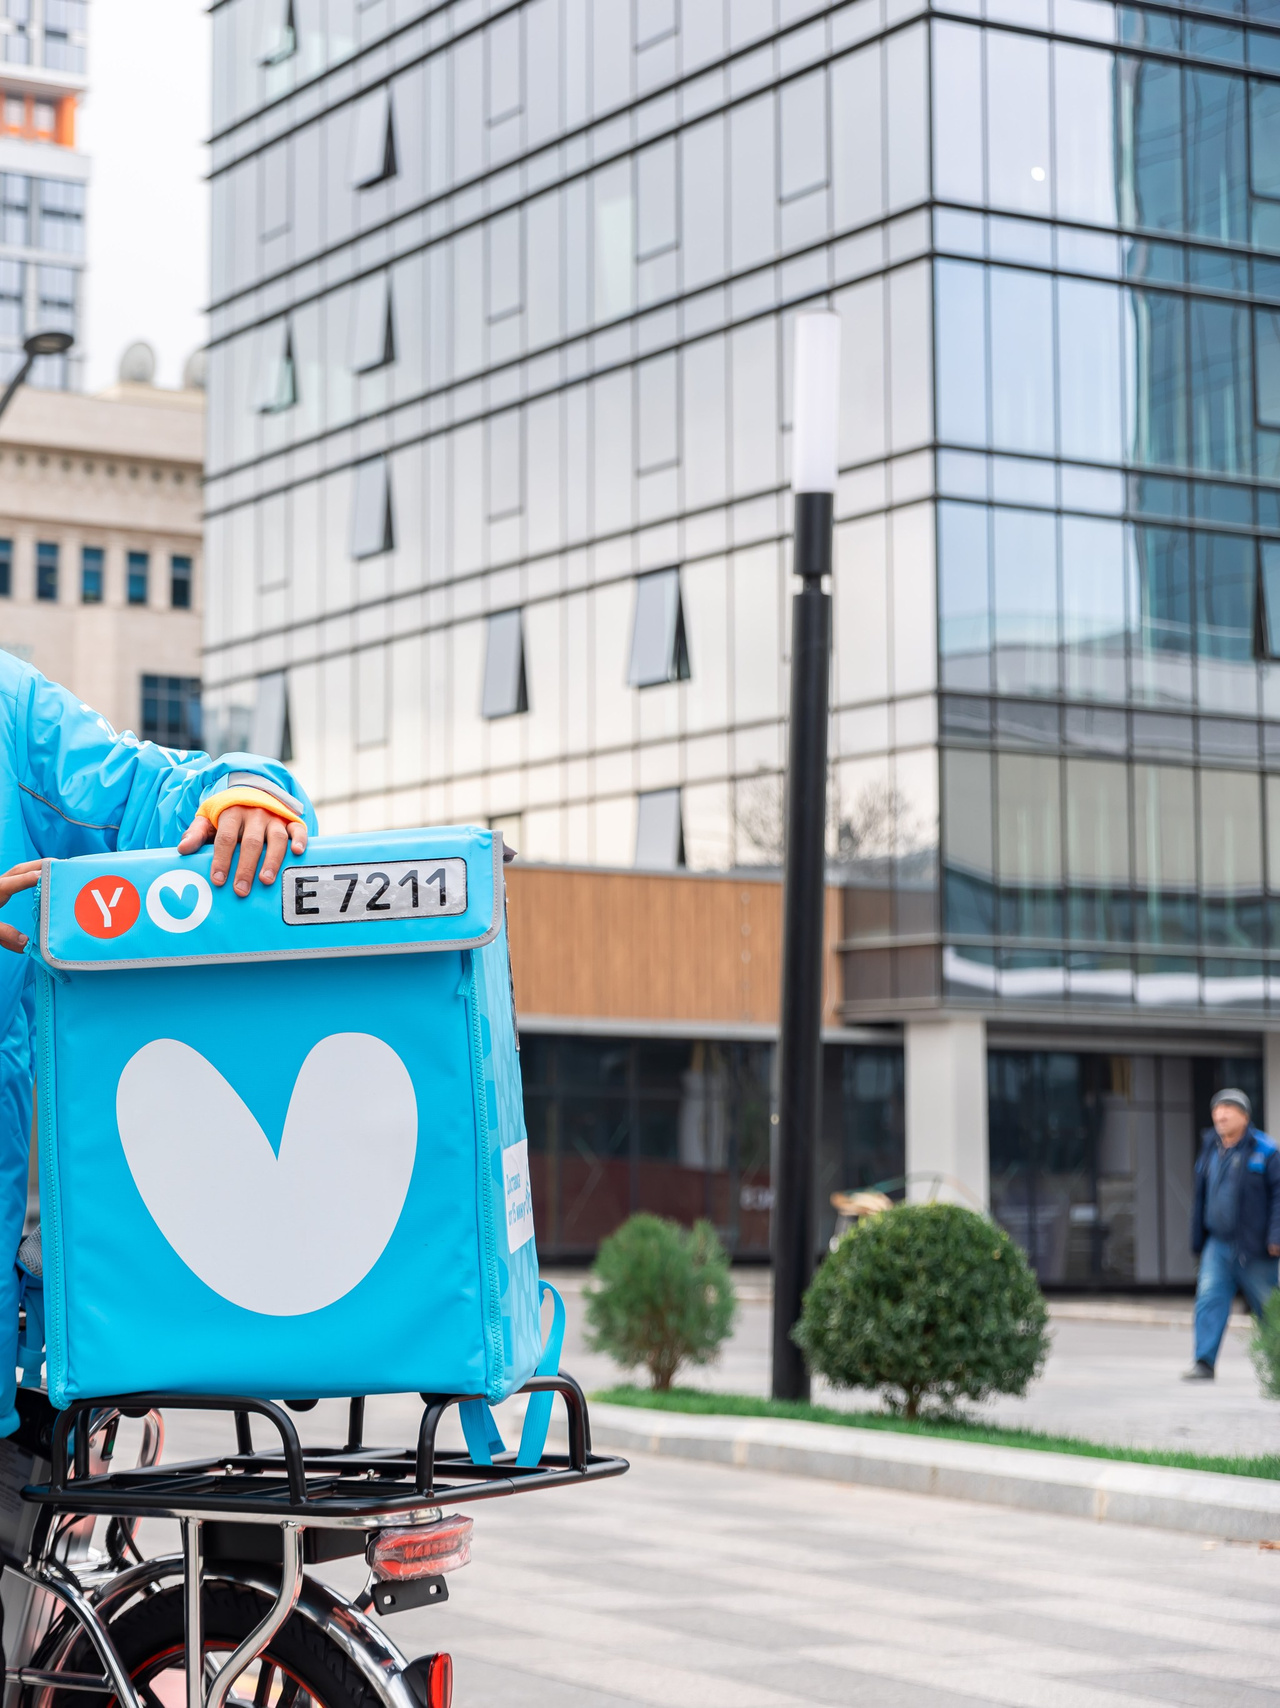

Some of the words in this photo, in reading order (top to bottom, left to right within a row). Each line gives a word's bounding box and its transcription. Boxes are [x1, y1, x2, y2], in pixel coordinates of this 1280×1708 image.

[90, 886, 124, 928] Y
[295, 875, 320, 915] E
[333, 868, 447, 913] 7211
